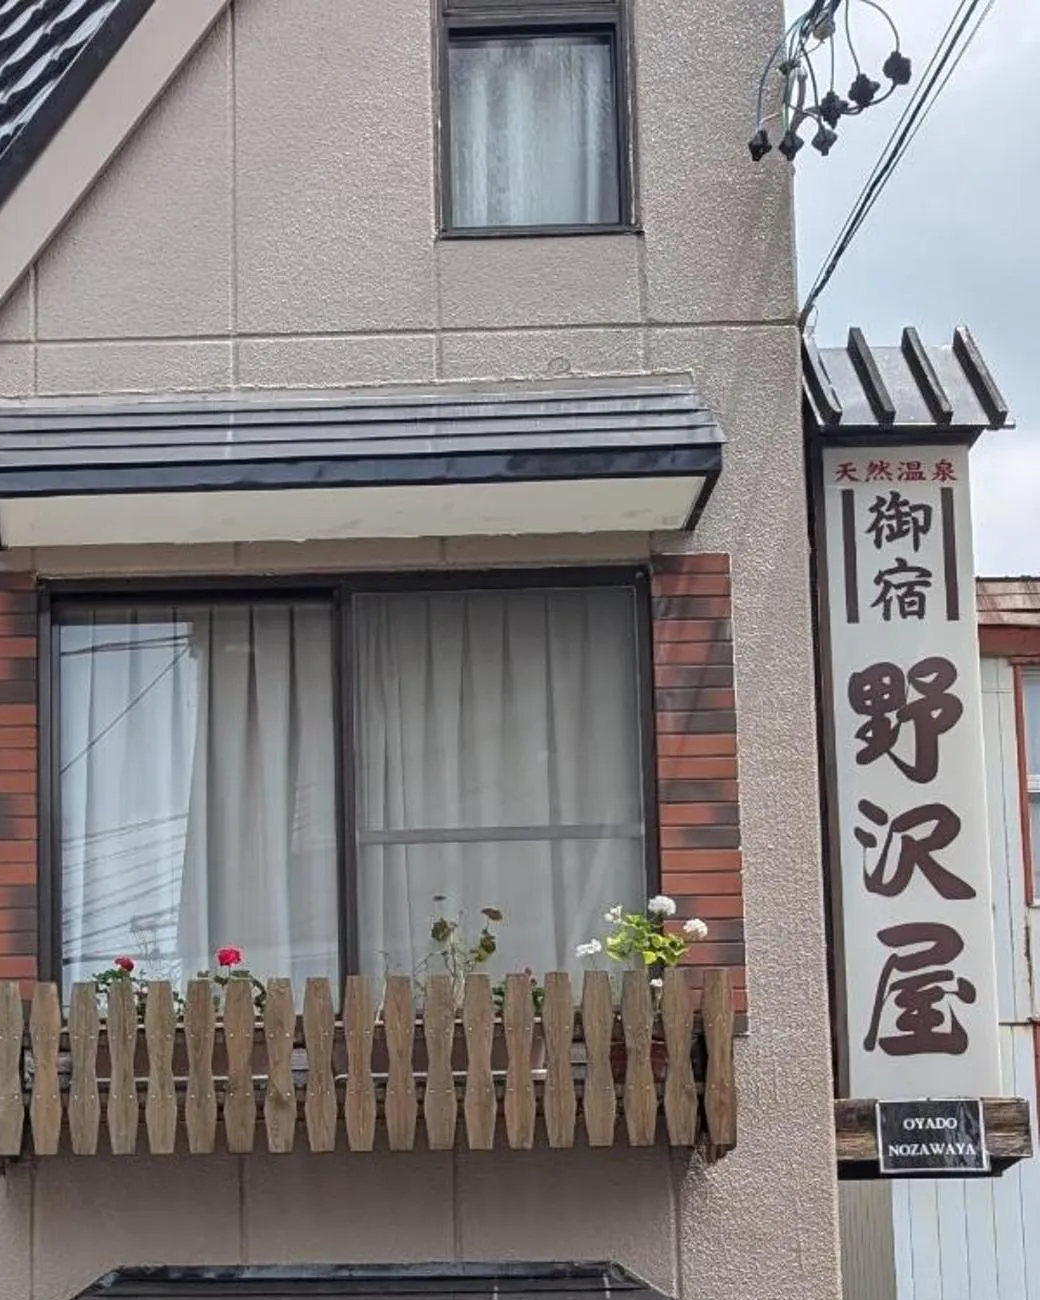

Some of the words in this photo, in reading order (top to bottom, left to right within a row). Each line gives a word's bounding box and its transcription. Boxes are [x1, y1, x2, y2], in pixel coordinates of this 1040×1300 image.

[835, 459, 958, 482] 天然温泉
[865, 490, 933, 622] 御宿
[848, 656, 977, 1056] 野沢屋
[902, 1117, 958, 1131] OYADO
[888, 1143, 977, 1157] NOZAWAYA
